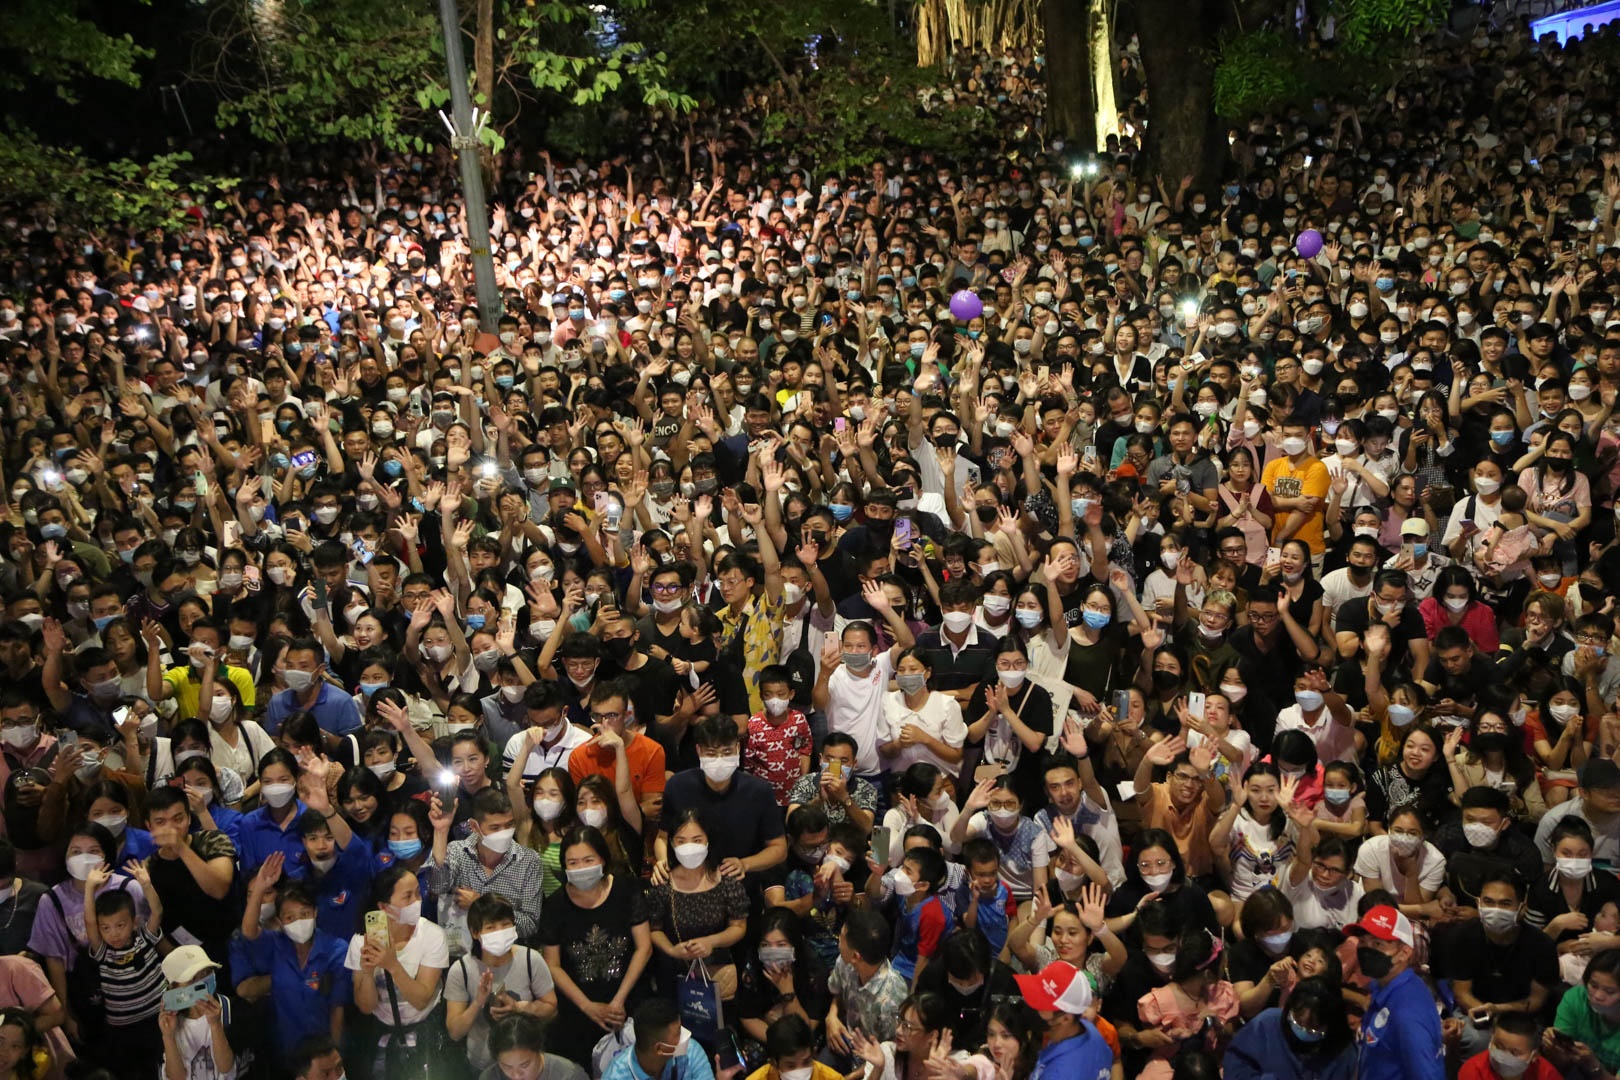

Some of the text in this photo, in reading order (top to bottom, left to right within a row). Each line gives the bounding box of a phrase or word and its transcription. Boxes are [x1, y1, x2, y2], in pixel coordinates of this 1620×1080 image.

[767, 741, 784, 752] ZX
[768, 761, 785, 771] ZX
[786, 767, 800, 780] XZ
